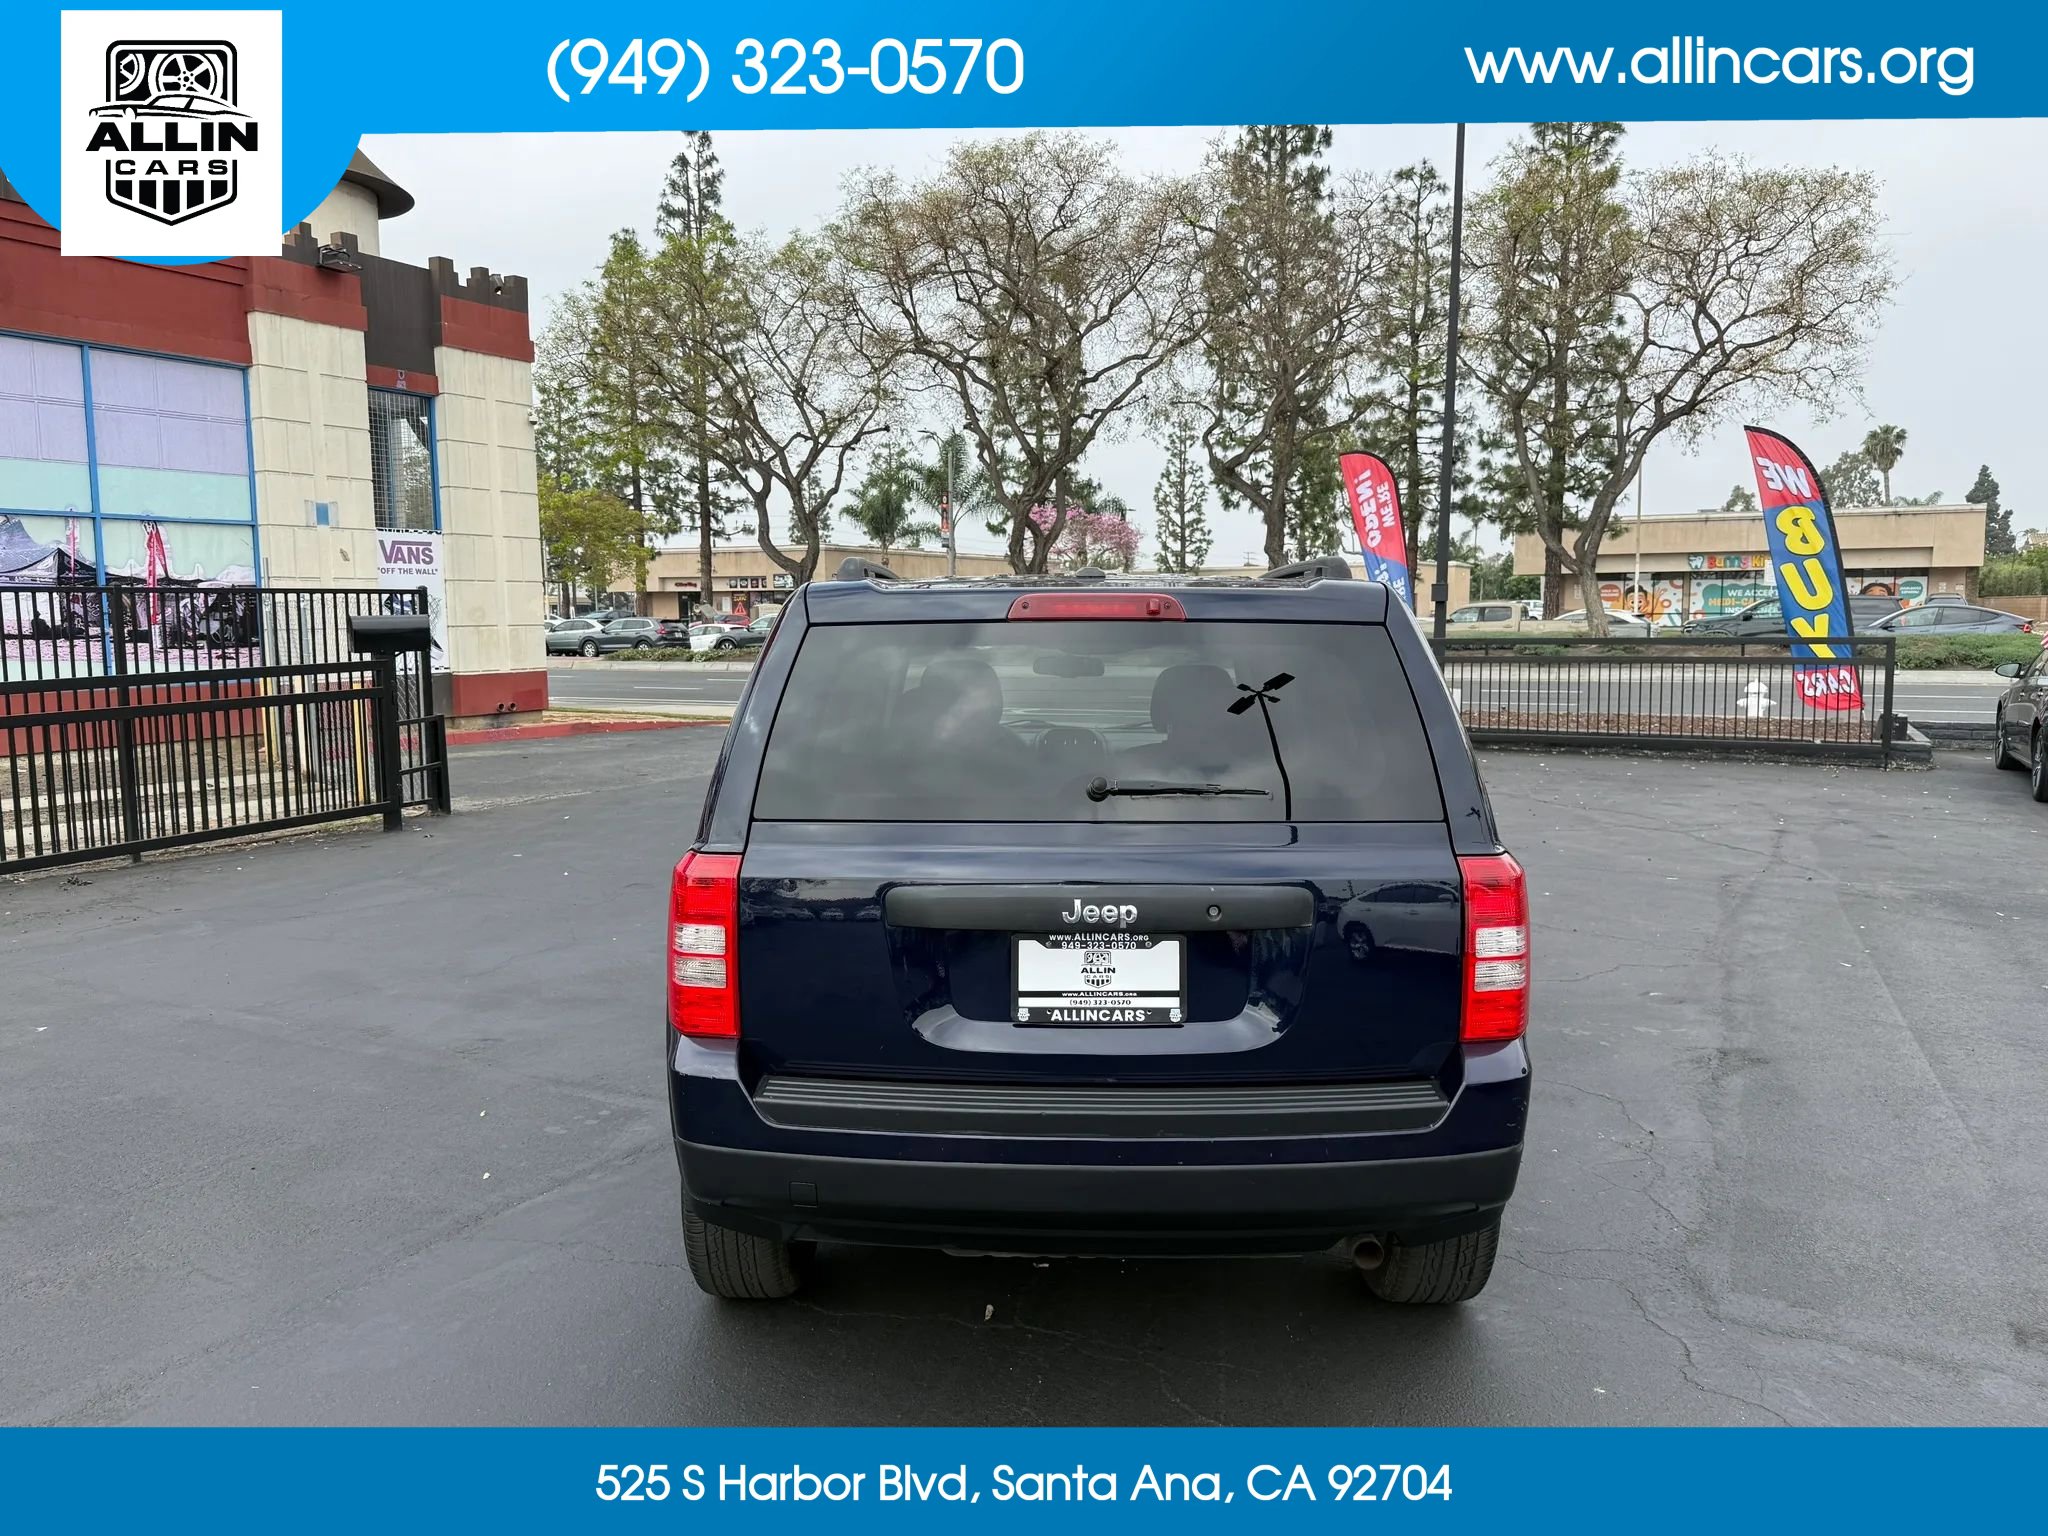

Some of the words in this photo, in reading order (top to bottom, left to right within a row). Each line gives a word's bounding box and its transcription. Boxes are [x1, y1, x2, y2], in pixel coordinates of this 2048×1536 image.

[378, 540, 434, 565] VANS
[398, 567, 413, 575] THE
[1727, 589, 1743, 597] WE
[1062, 898, 1138, 928] Jeep
[1061, 941, 1137, 950] 949-323-0570
[1050, 1009, 1146, 1022] ALLINCARS
